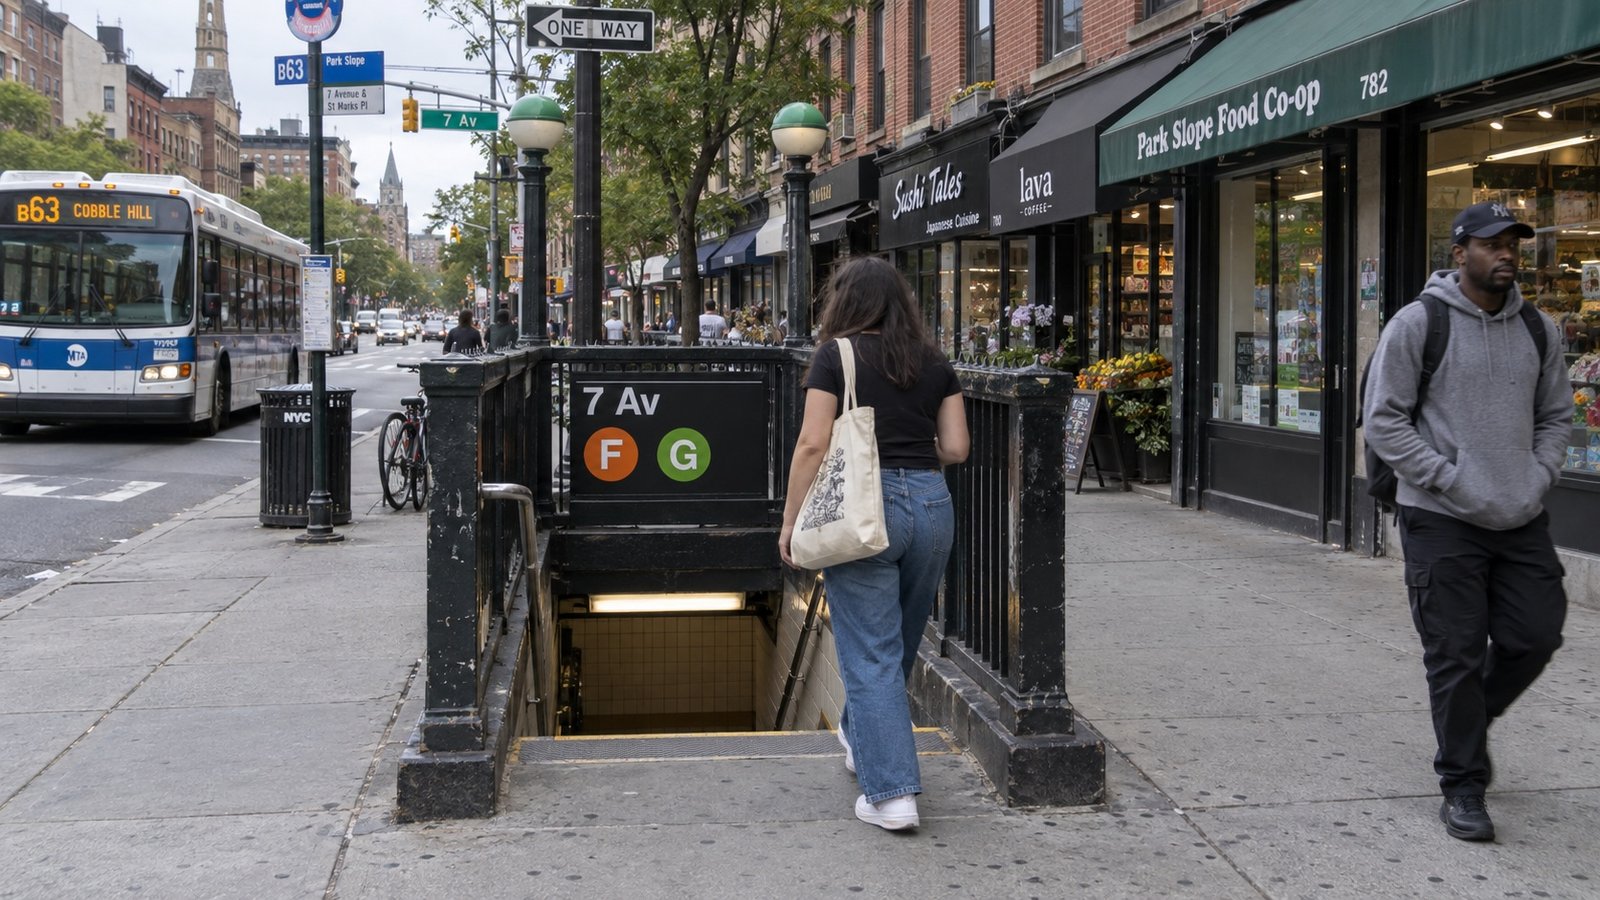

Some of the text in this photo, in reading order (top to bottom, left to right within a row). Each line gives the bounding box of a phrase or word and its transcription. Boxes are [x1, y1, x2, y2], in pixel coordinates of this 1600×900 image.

[547, 20, 638, 38] ONE WAY
[278, 59, 304, 80] B63
[326, 55, 366, 67] Park Slope
[327, 90, 333, 99] 7
[334, 89, 360, 99] Avenue
[1360, 69, 1388, 100] 782
[327, 102, 335, 111] St
[360, 101, 368, 110] Pl
[443, 113, 478, 128] 7 Av
[1137, 79, 1321, 160] Park Slope Food Co-op
[892, 162, 963, 220] Sushi Tales
[1019, 167, 1054, 203] lava
[17, 196, 153, 223] B63 COBBLE HILL
[926, 211, 980, 236] Japanese Cuisine
[67, 349, 87, 361] MTA
[583, 387, 661, 416] 7 Av
[283, 412, 312, 423] NYC
[600, 439, 698, 470] F G
